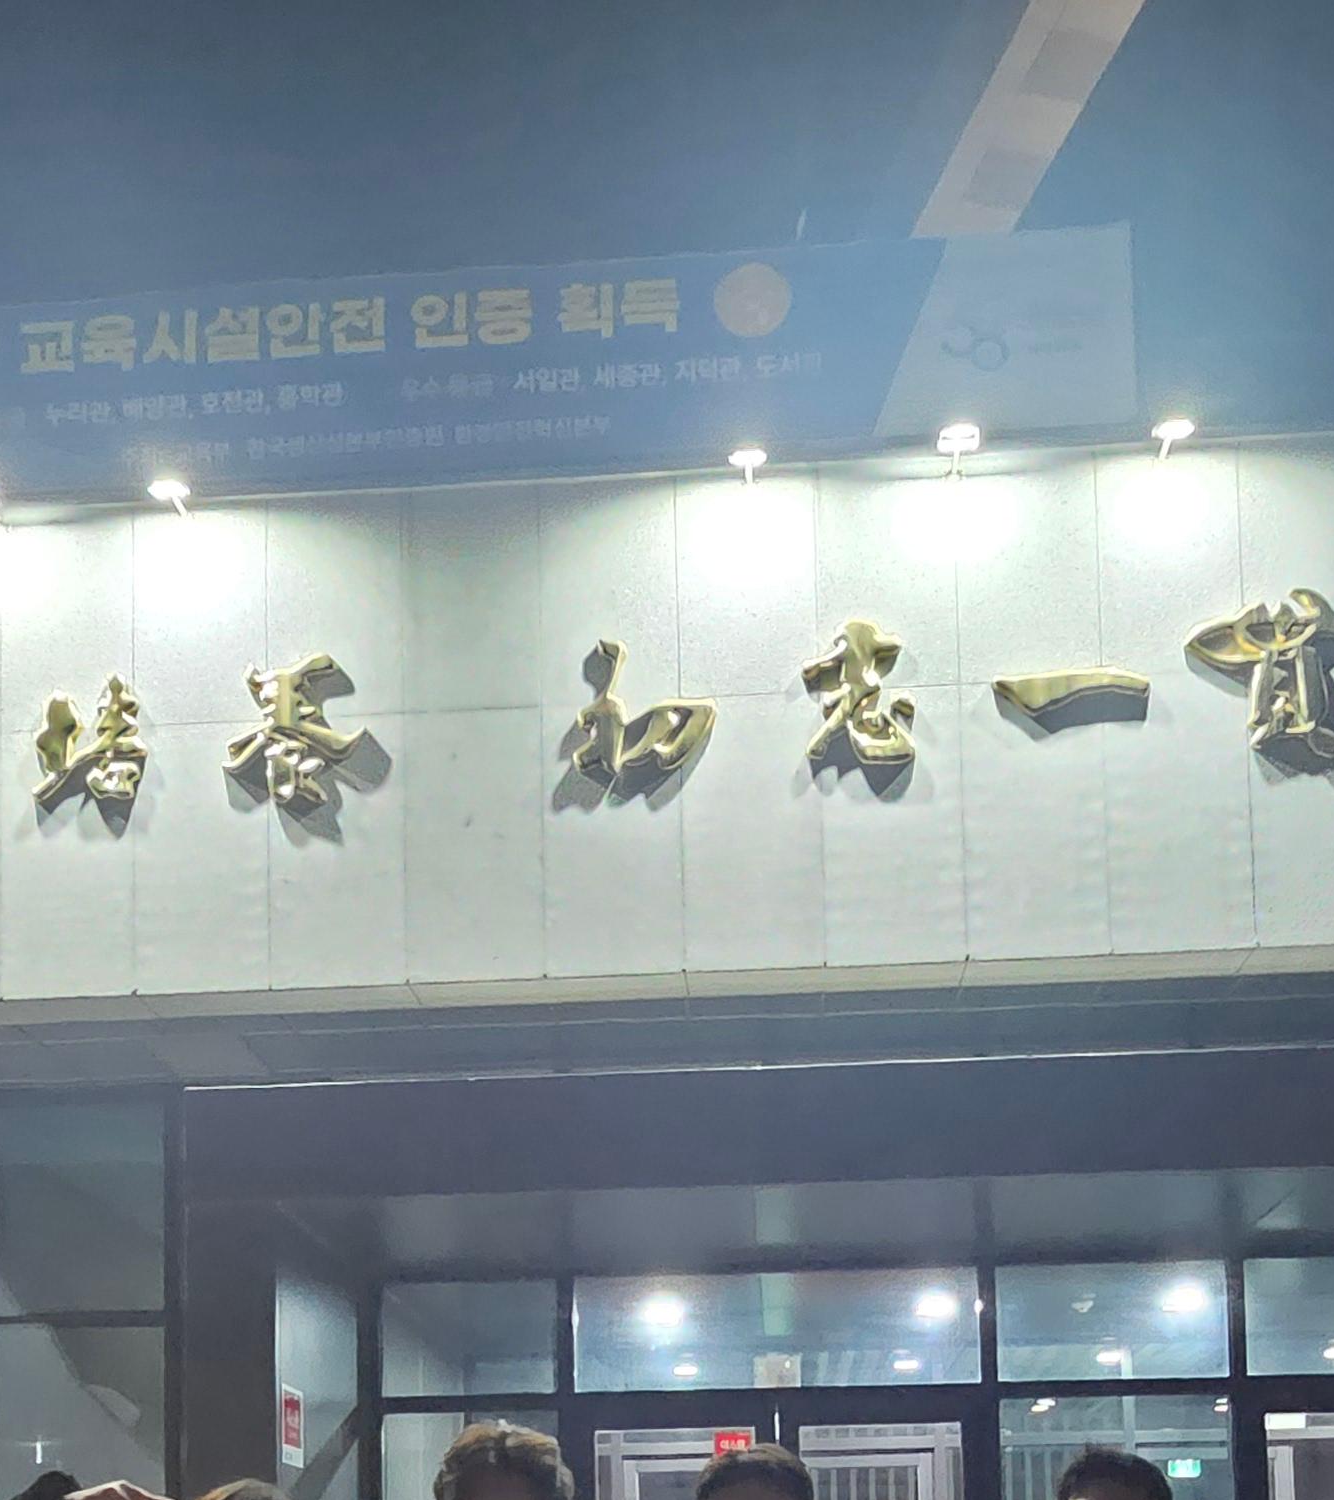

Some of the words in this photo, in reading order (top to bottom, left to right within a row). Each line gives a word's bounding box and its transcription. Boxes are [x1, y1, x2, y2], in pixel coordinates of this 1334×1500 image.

[19, 297, 387, 375] 교육시설안전
[410, 287, 533, 349] 인증
[557, 278, 680, 340] 획득
